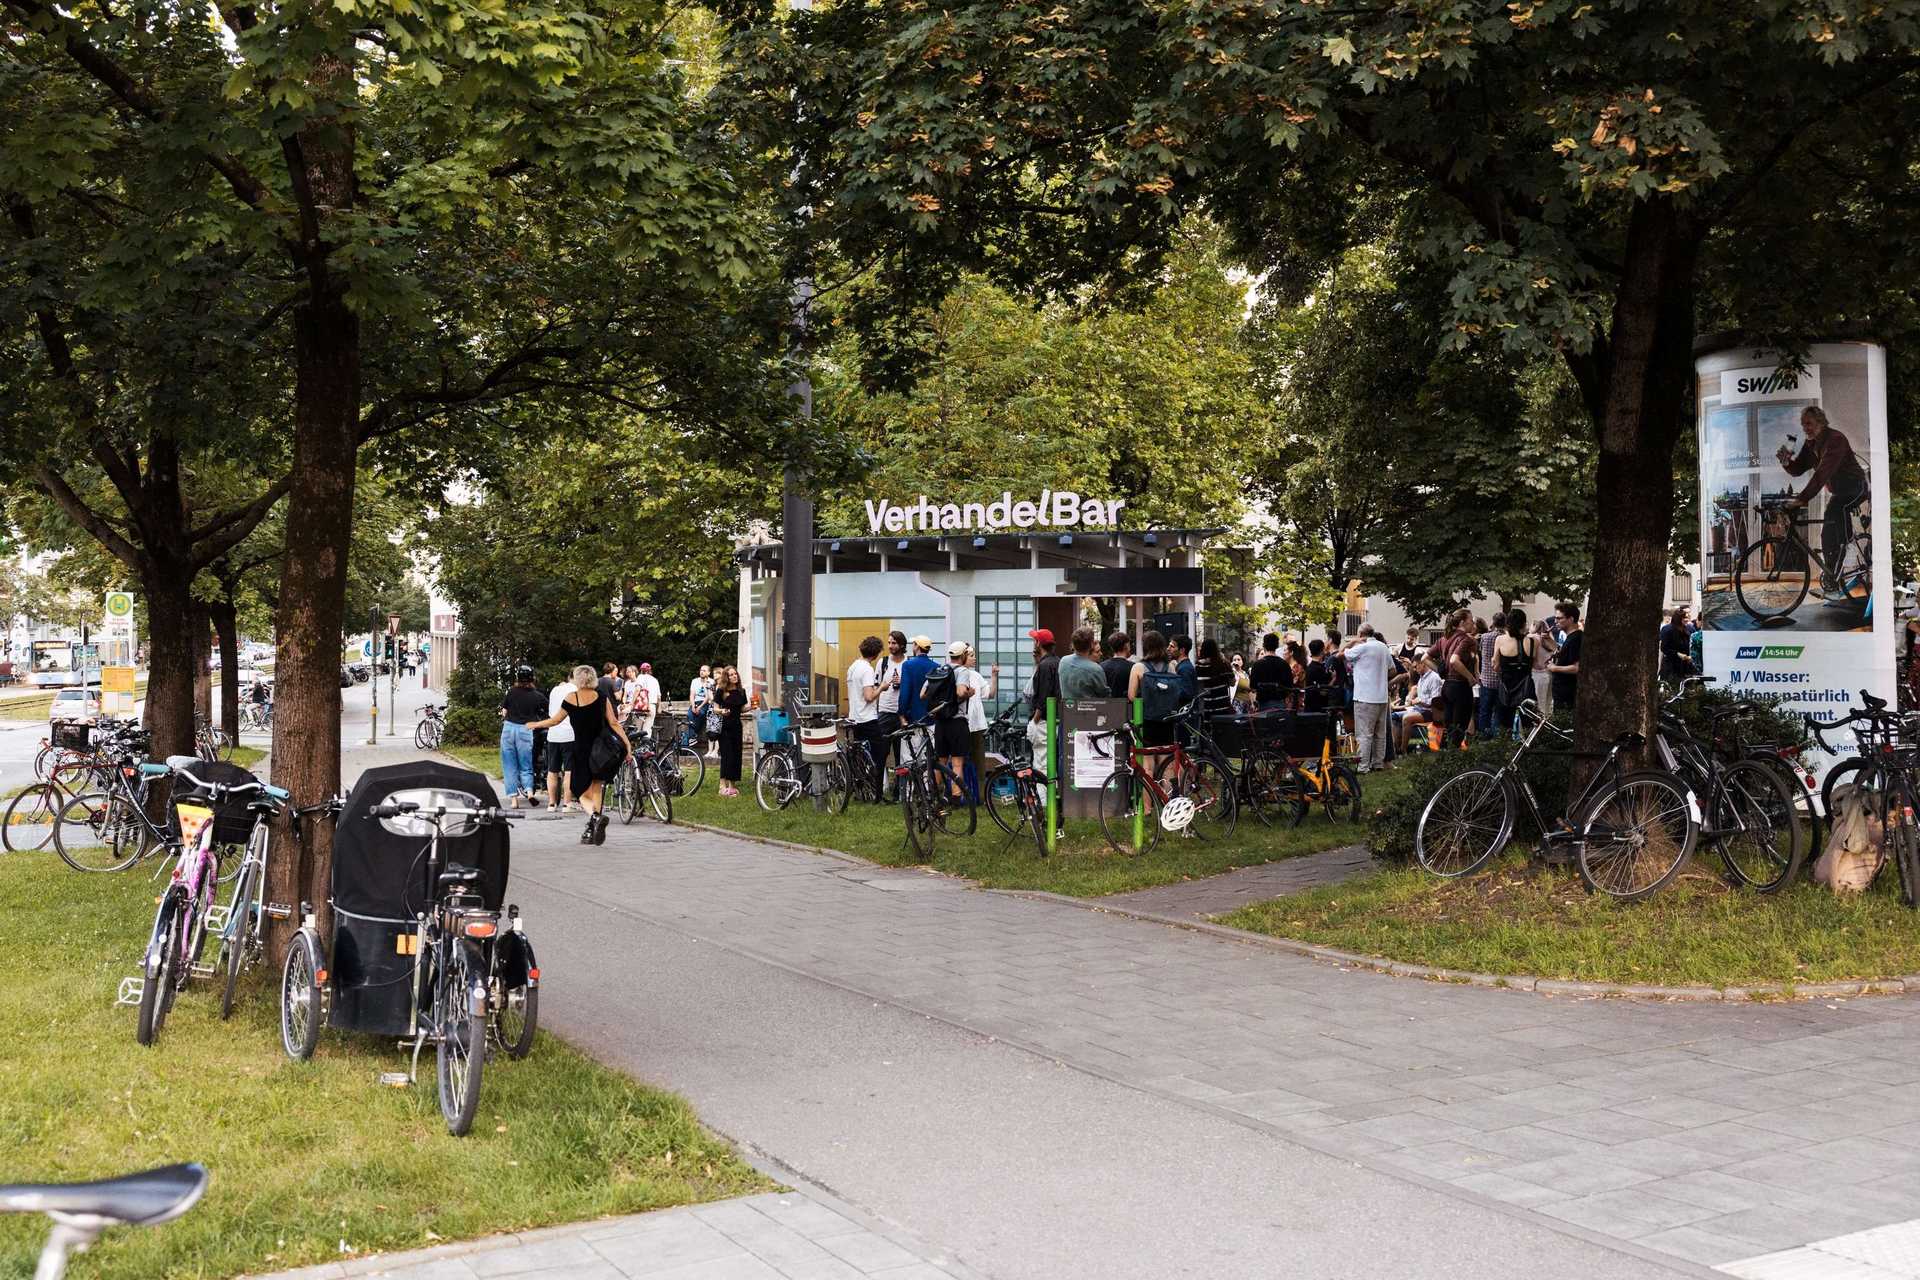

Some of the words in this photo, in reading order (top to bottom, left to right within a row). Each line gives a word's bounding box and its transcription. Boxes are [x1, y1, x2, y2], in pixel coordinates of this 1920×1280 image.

[864, 488, 1126, 532] VerhandelBar
[1739, 649, 1757, 657] Lehel
[1730, 670, 1742, 683] M
[1753, 670, 1810, 683] Wasser:
[1735, 689, 1779, 701] Alfons
